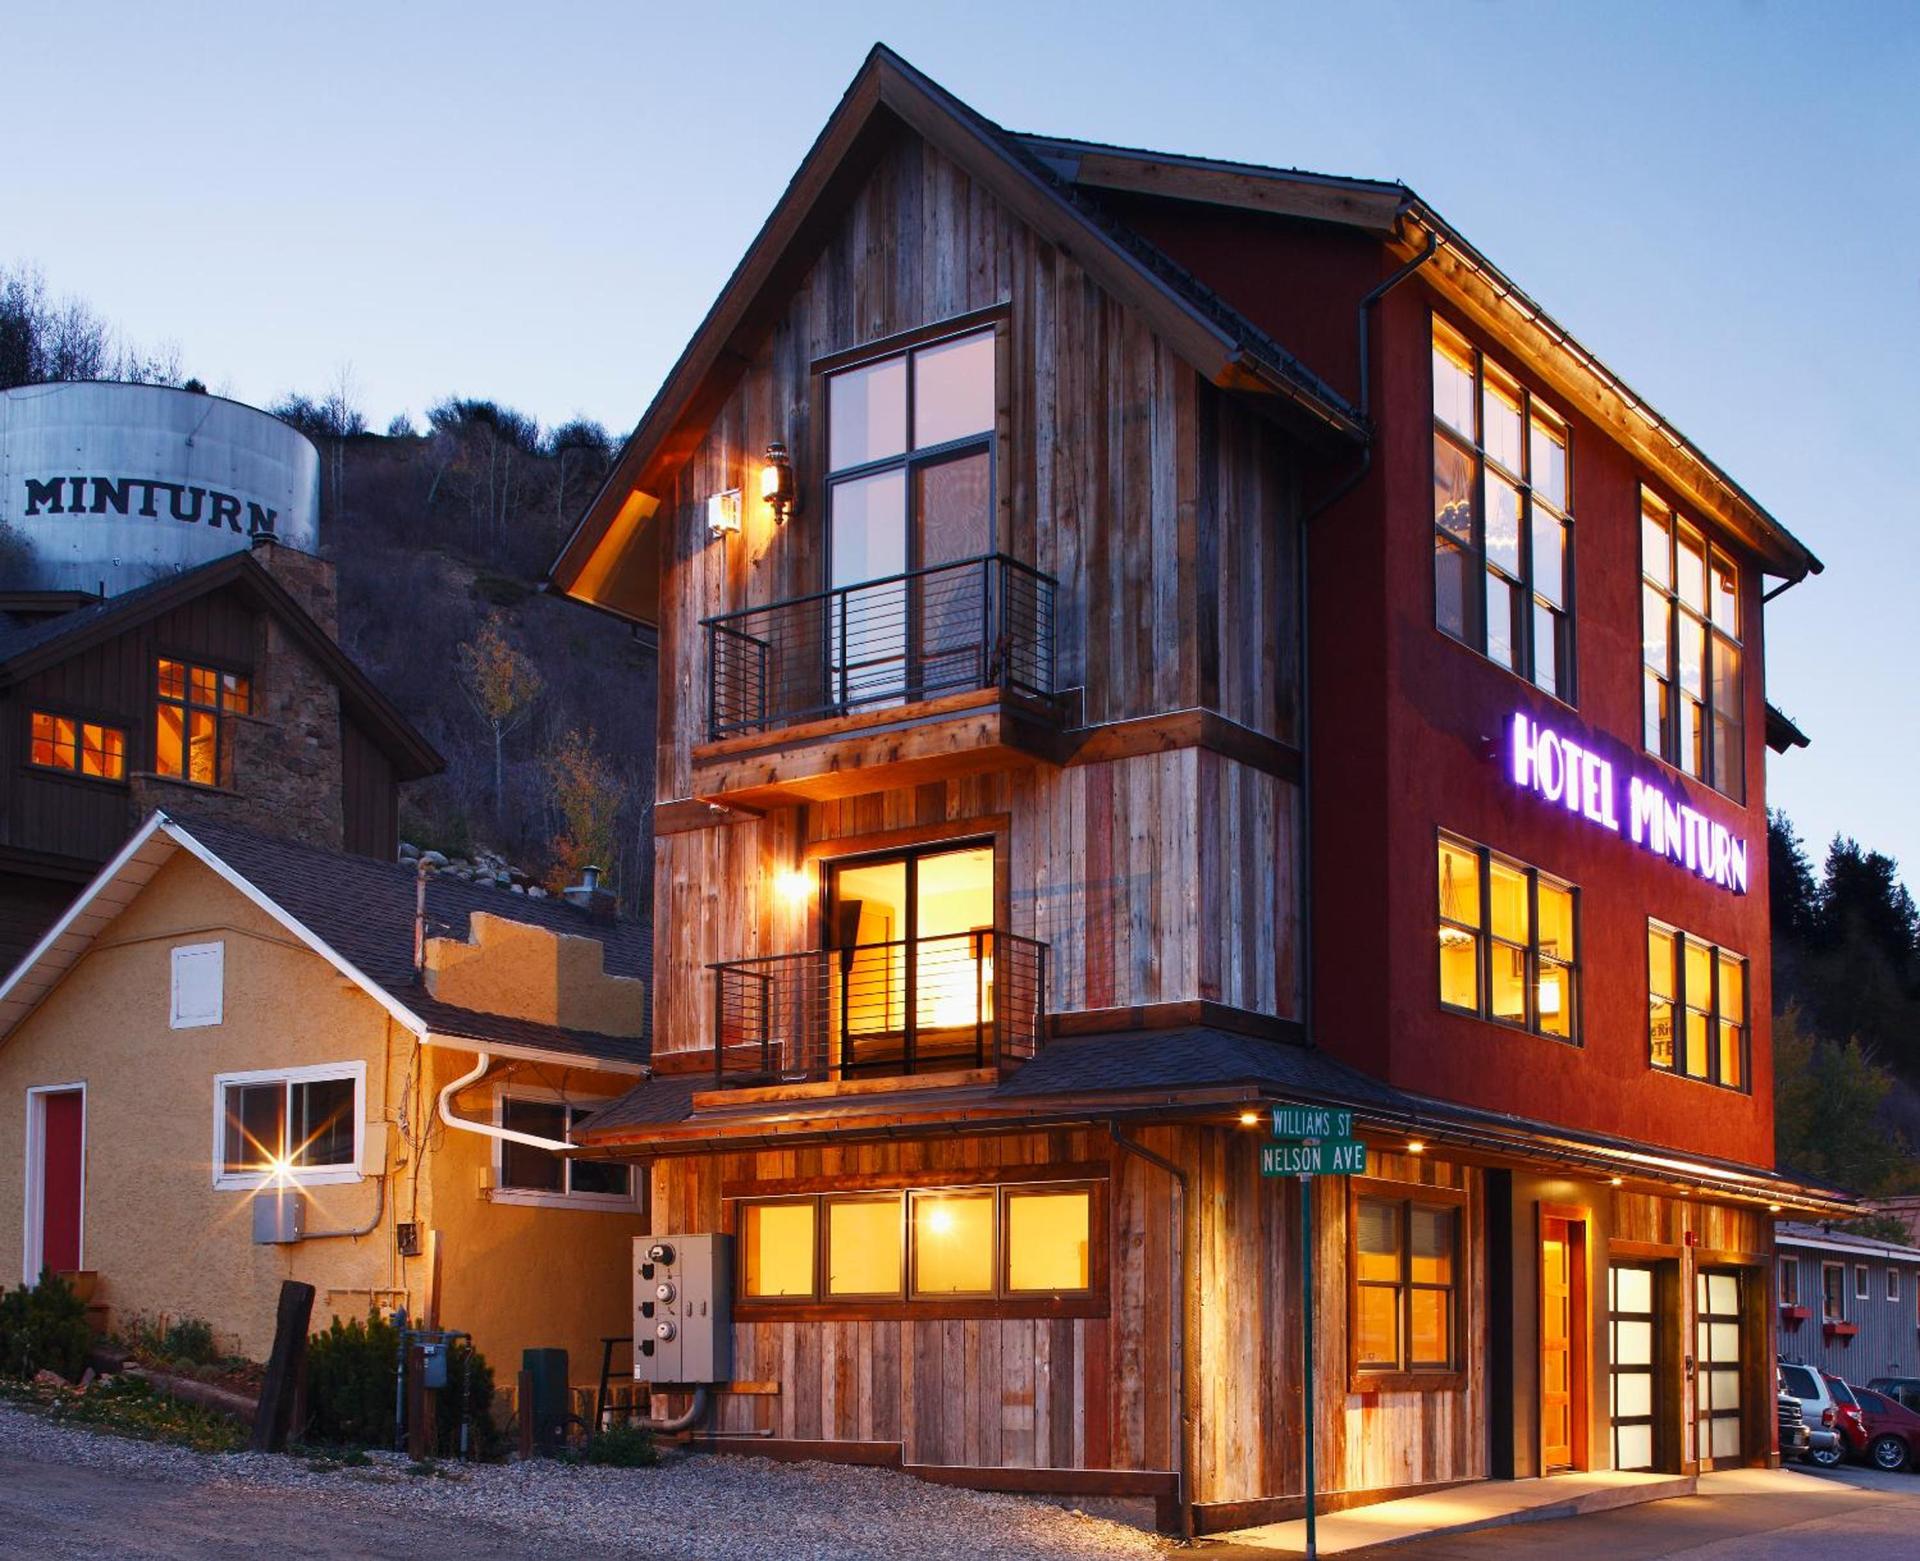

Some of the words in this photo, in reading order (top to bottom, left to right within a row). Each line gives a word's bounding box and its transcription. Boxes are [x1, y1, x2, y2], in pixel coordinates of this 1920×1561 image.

[25, 477, 277, 536] MINTURN
[1513, 711, 1619, 832] HOTEL
[1629, 776, 1748, 896] MINTURN
[1273, 1110, 1330, 1136] WILLIAMS
[1338, 1113, 1351, 1136] ST
[1264, 1147, 1321, 1171] NELSON
[1333, 1145, 1363, 1169] AVE
